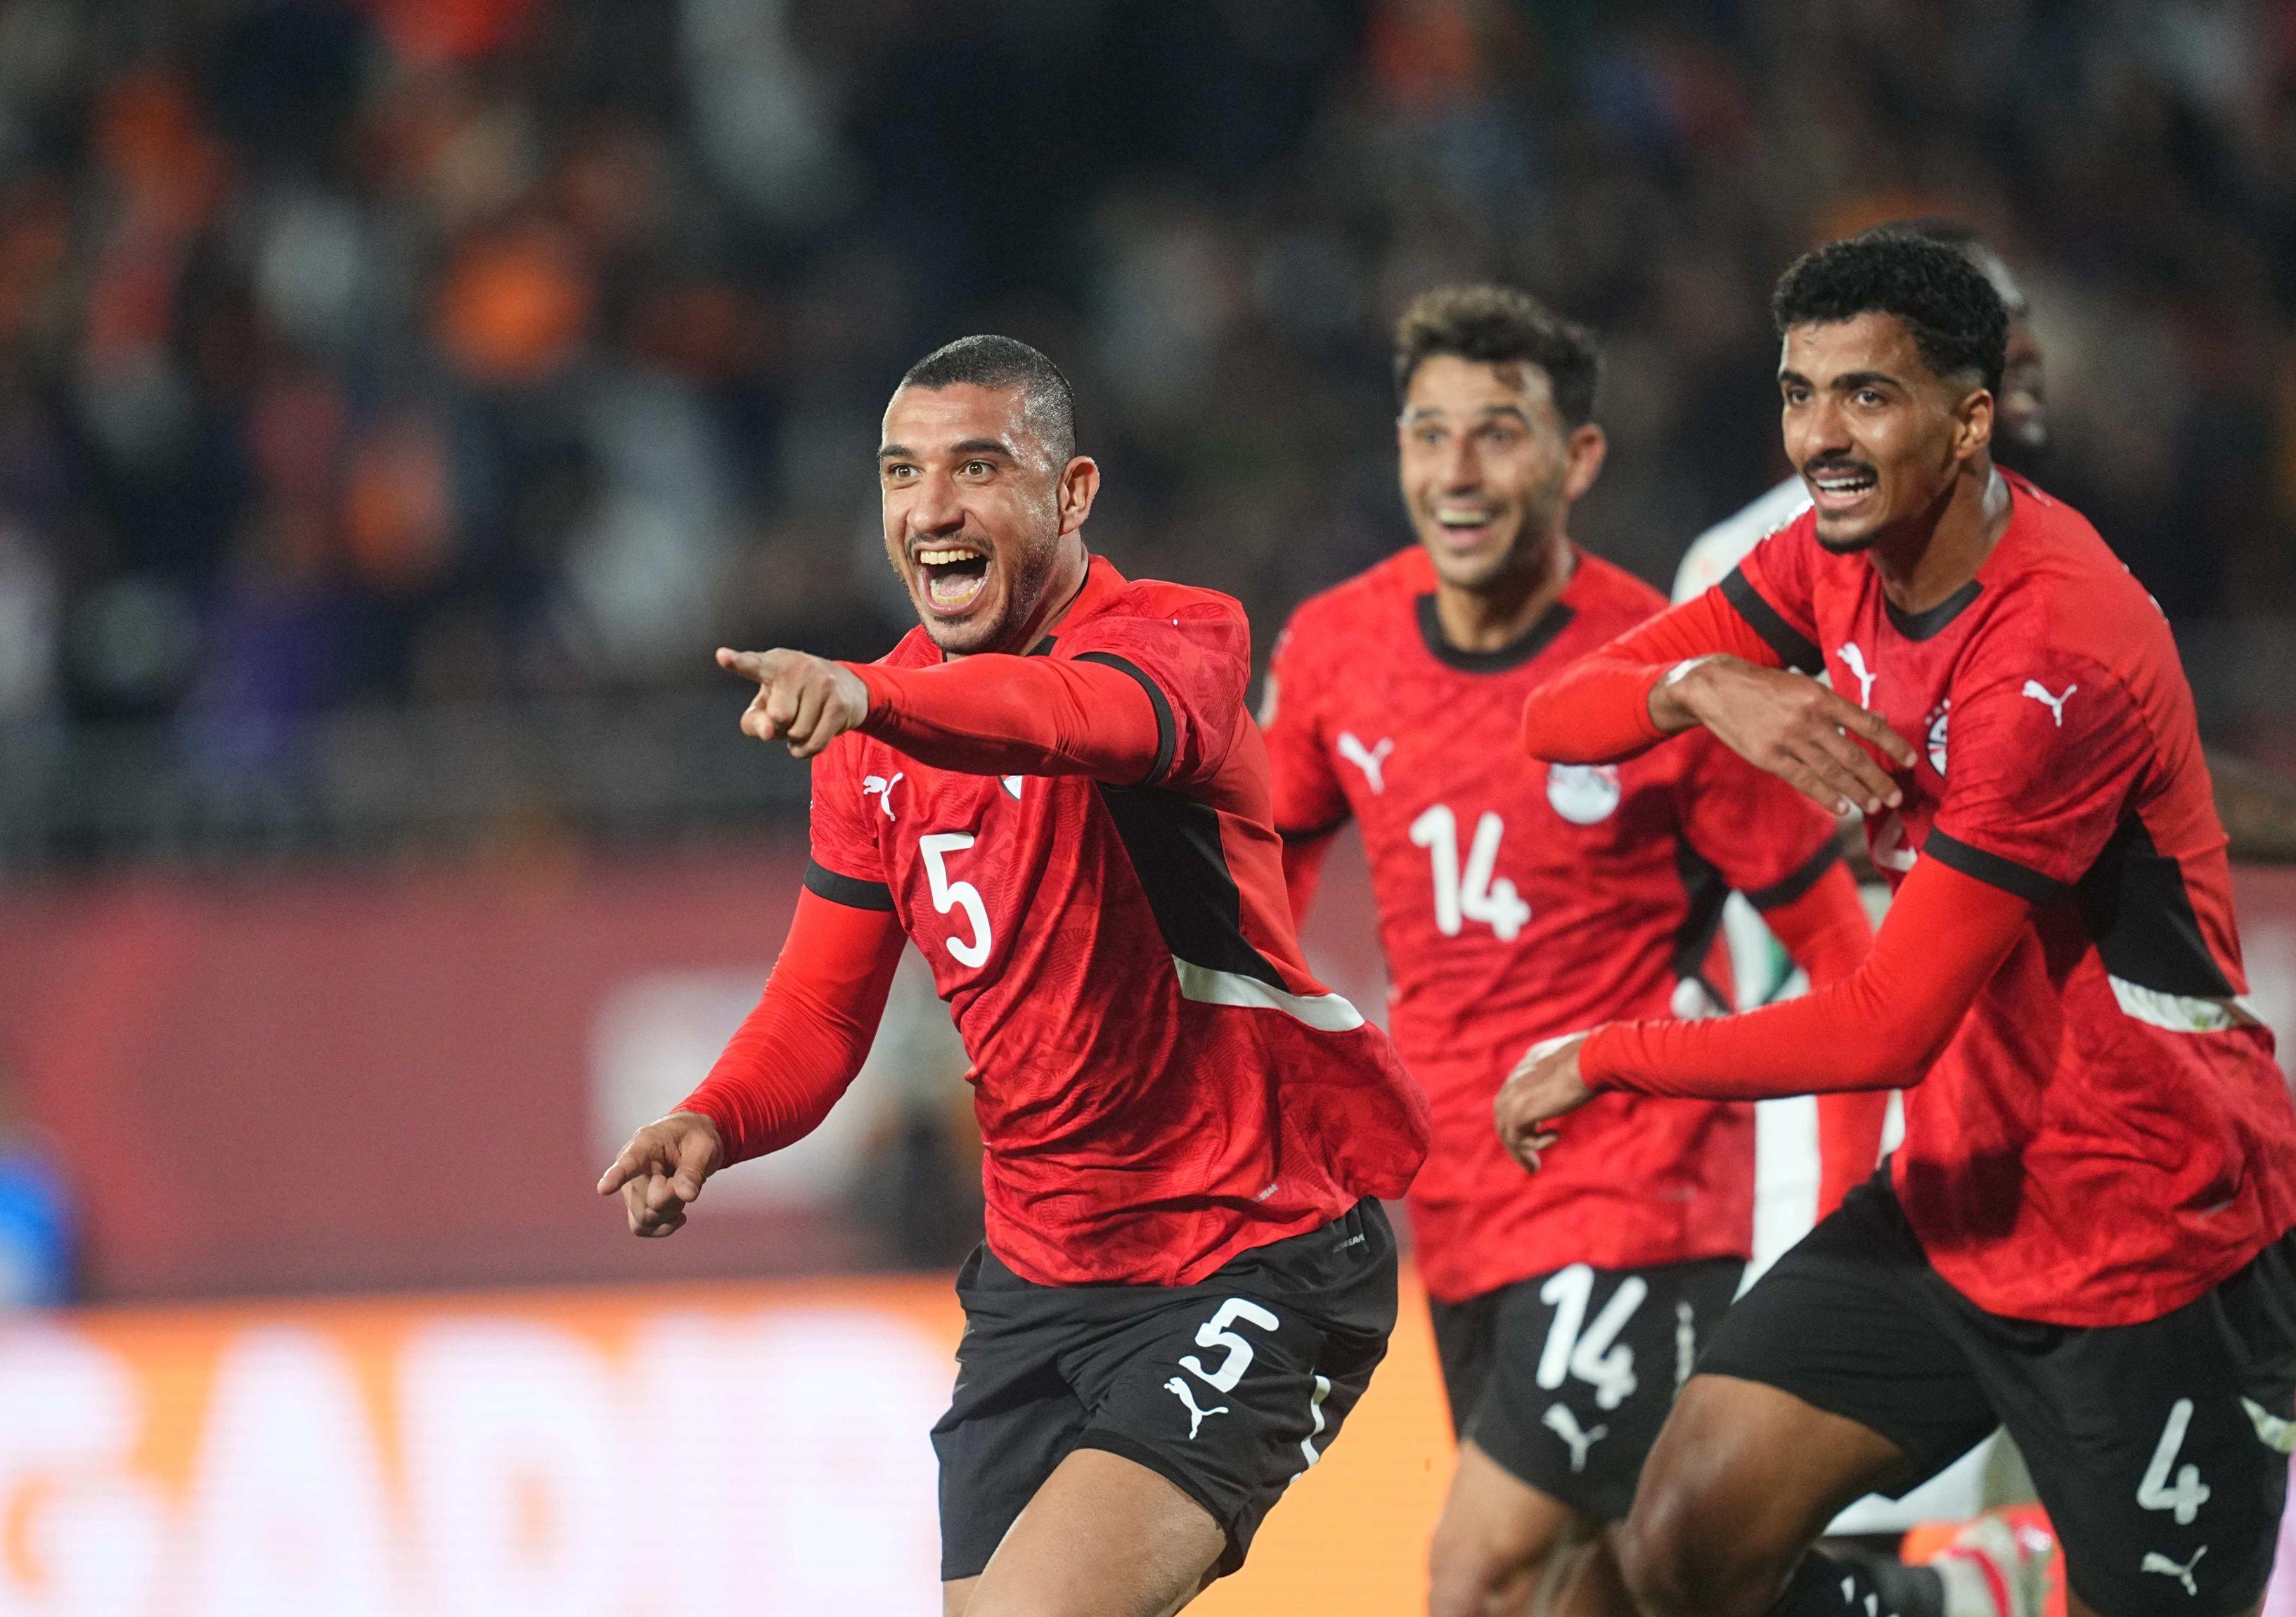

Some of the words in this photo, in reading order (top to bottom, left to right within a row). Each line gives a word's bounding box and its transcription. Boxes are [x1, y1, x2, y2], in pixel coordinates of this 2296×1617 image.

[919, 832, 992, 968] 5
[1409, 803, 1531, 942] 14
[1178, 1297, 1279, 1393] 5
[1536, 1263, 1647, 1409] 14
[2136, 1398, 2211, 1525] 4
